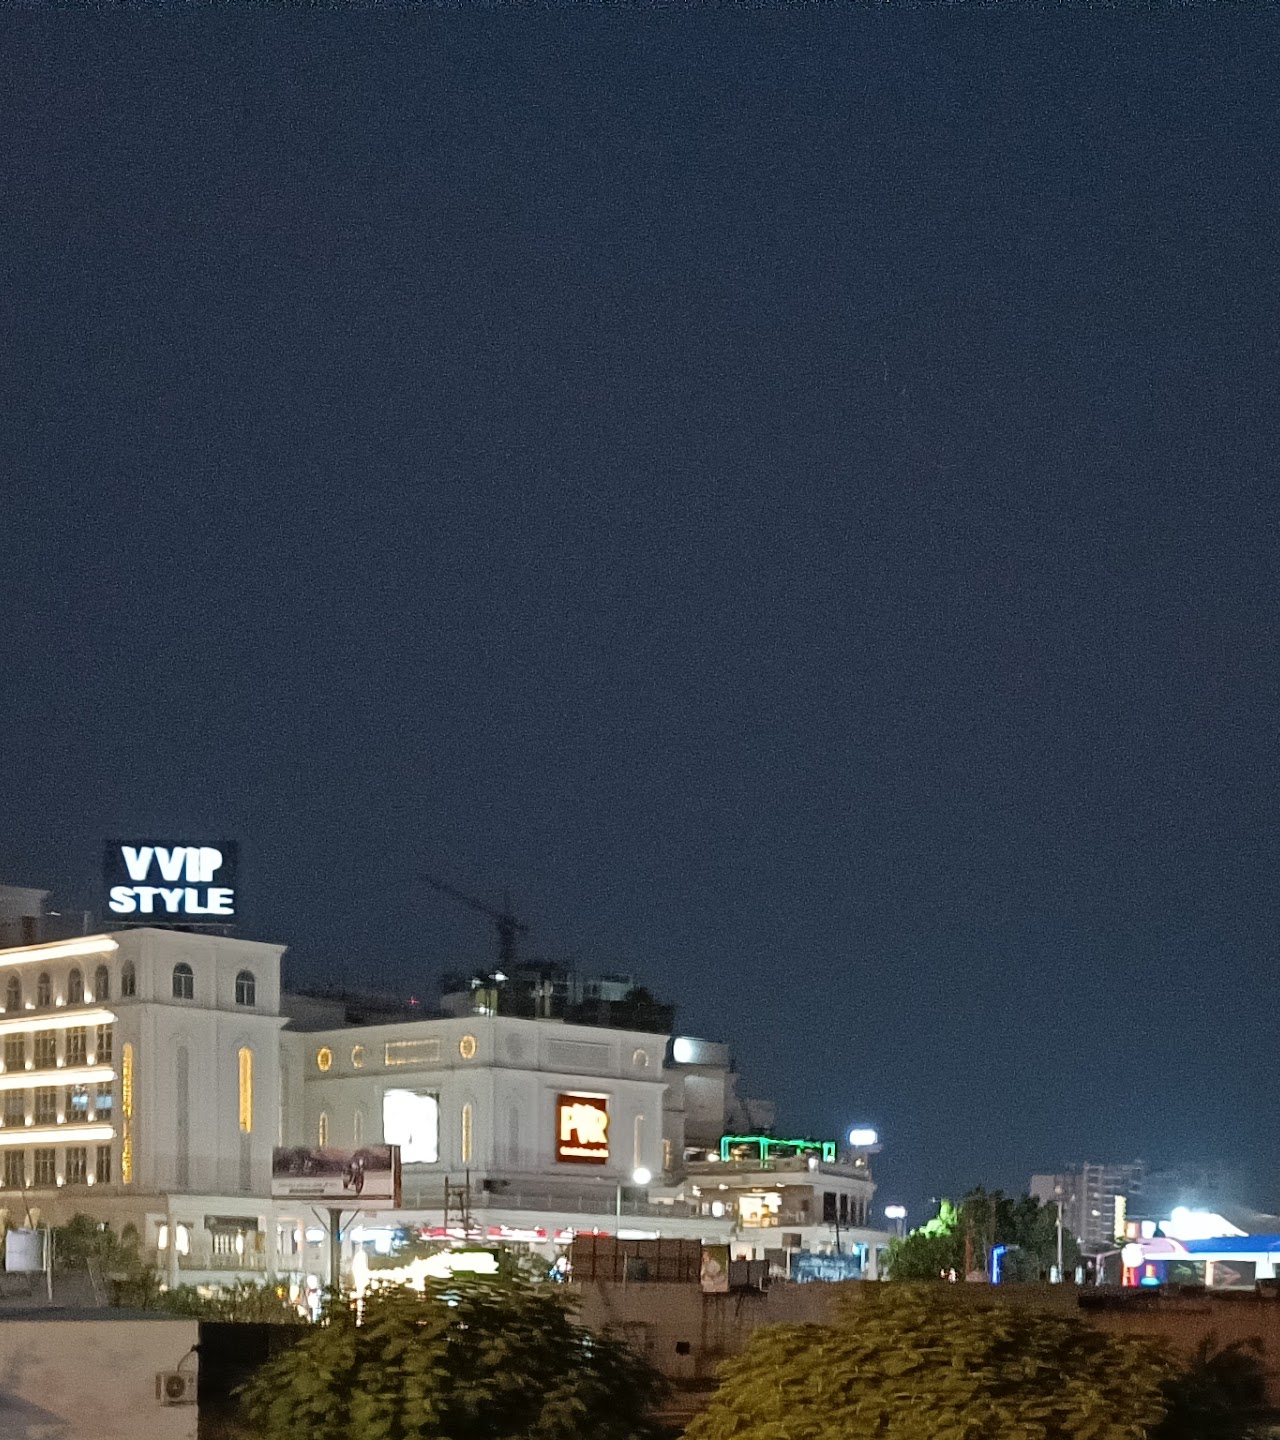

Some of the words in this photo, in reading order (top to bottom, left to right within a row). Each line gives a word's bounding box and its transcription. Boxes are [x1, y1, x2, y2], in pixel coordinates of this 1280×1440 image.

[121, 846, 223, 882] VVIP
[108, 886, 235, 915] STYLE
[560, 1103, 609, 1144] PVR
